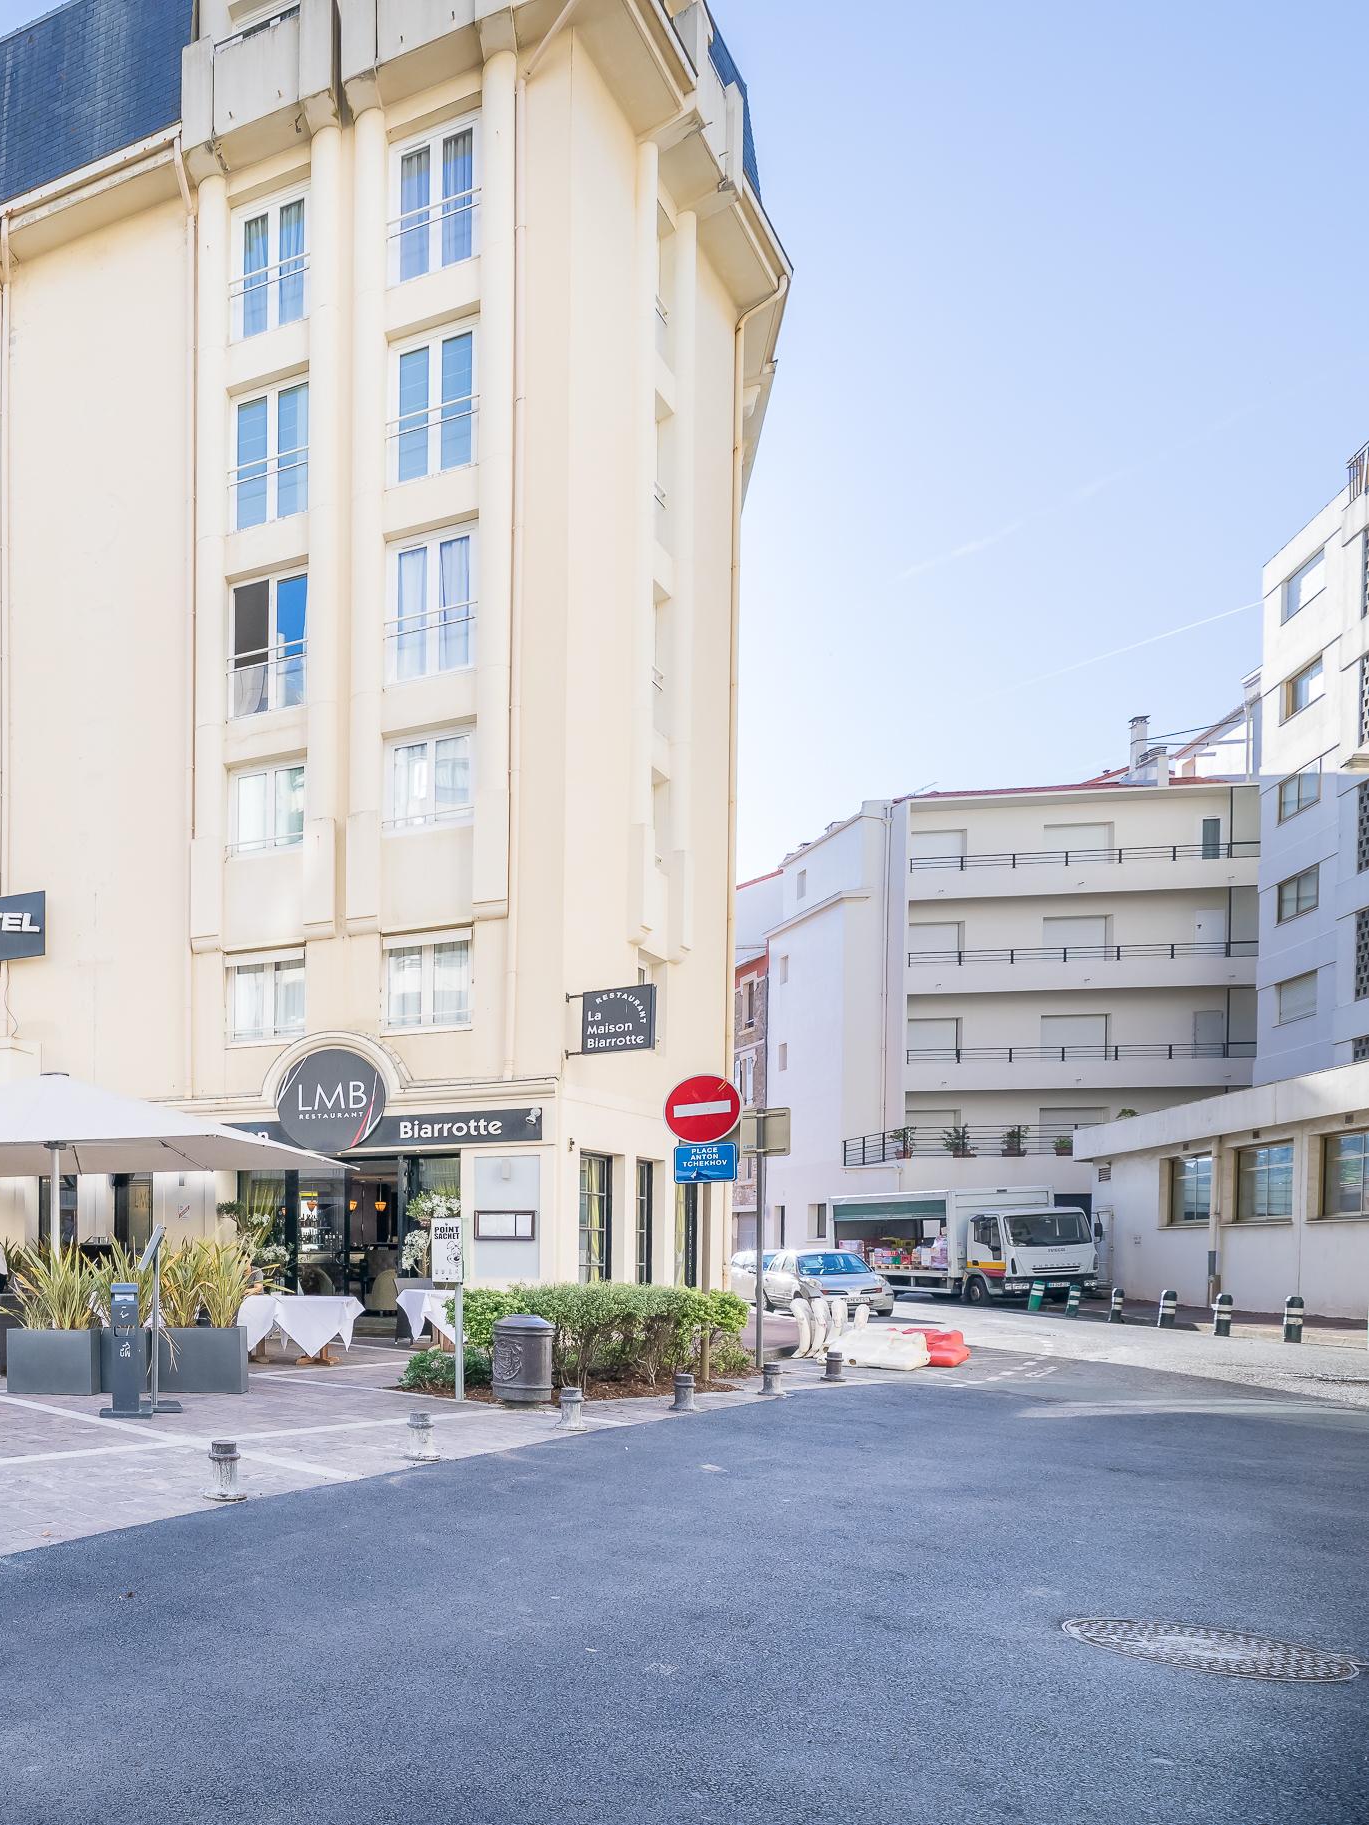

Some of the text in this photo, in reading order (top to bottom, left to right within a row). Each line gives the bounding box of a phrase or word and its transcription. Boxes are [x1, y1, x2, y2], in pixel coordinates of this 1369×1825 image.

[595, 992, 647, 1024] RESTAURANT
[587, 1010, 602, 1022] La
[586, 1022, 633, 1035] Maison
[587, 1034, 645, 1049] Biarrotte
[298, 1081, 366, 1111] LMB
[298, 1111, 364, 1120] RESTAURANT
[399, 1118, 503, 1139] Biarrotte
[691, 1146, 718, 1154] PLACE
[682, 1159, 728, 1168] TCHEKHOV
